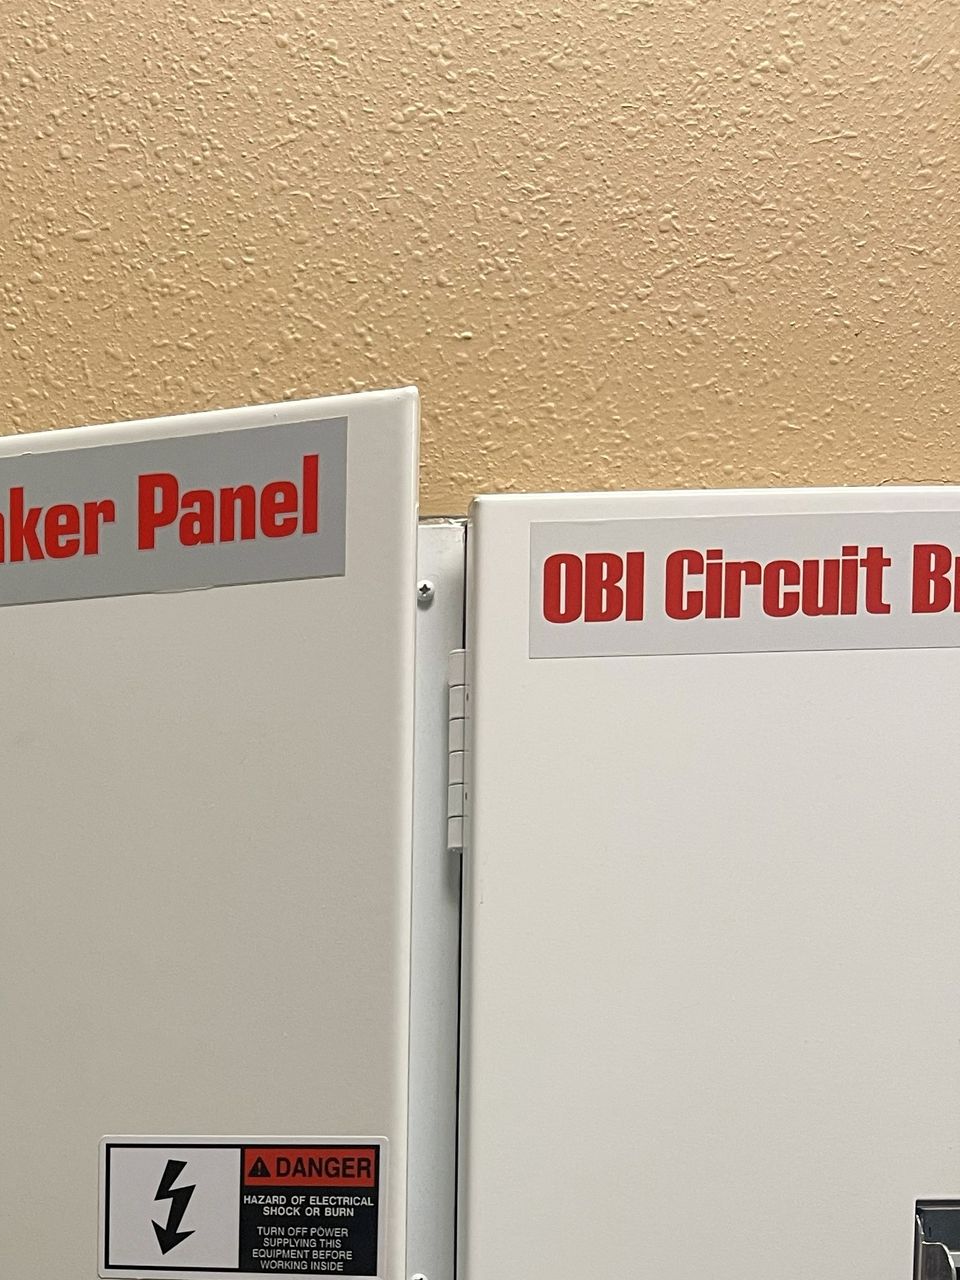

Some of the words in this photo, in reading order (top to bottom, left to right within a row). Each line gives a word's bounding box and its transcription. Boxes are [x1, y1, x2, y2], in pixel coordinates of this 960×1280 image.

[137, 454, 320, 549] Panel
[543, 551, 645, 624] OBI
[665, 545, 891, 620] Circuit
[912, 543, 960, 614] B
[276, 1157, 371, 1178] DANGER
[243, 1195, 287, 1206] HAZARD
[290, 1196, 306, 1206] OF
[309, 1196, 374, 1206] ELECTRICAL
[262, 1206, 301, 1216] SHOCK
[304, 1206, 320, 1217] OR
[324, 1207, 354, 1217] BURN
[257, 1226, 285, 1236] TURN
[287, 1227, 308, 1236] OFF
[310, 1227, 348, 1236] POWER
[263, 1238, 317, 1248] SUPPLYING
[319, 1239, 342, 1249] THIS
[252, 1249, 310, 1259] EQUIPMENT
[312, 1250, 353, 1259] BEFORE
[260, 1260, 308, 1270] WORKING
[310, 1261, 344, 1271] INSIDE
